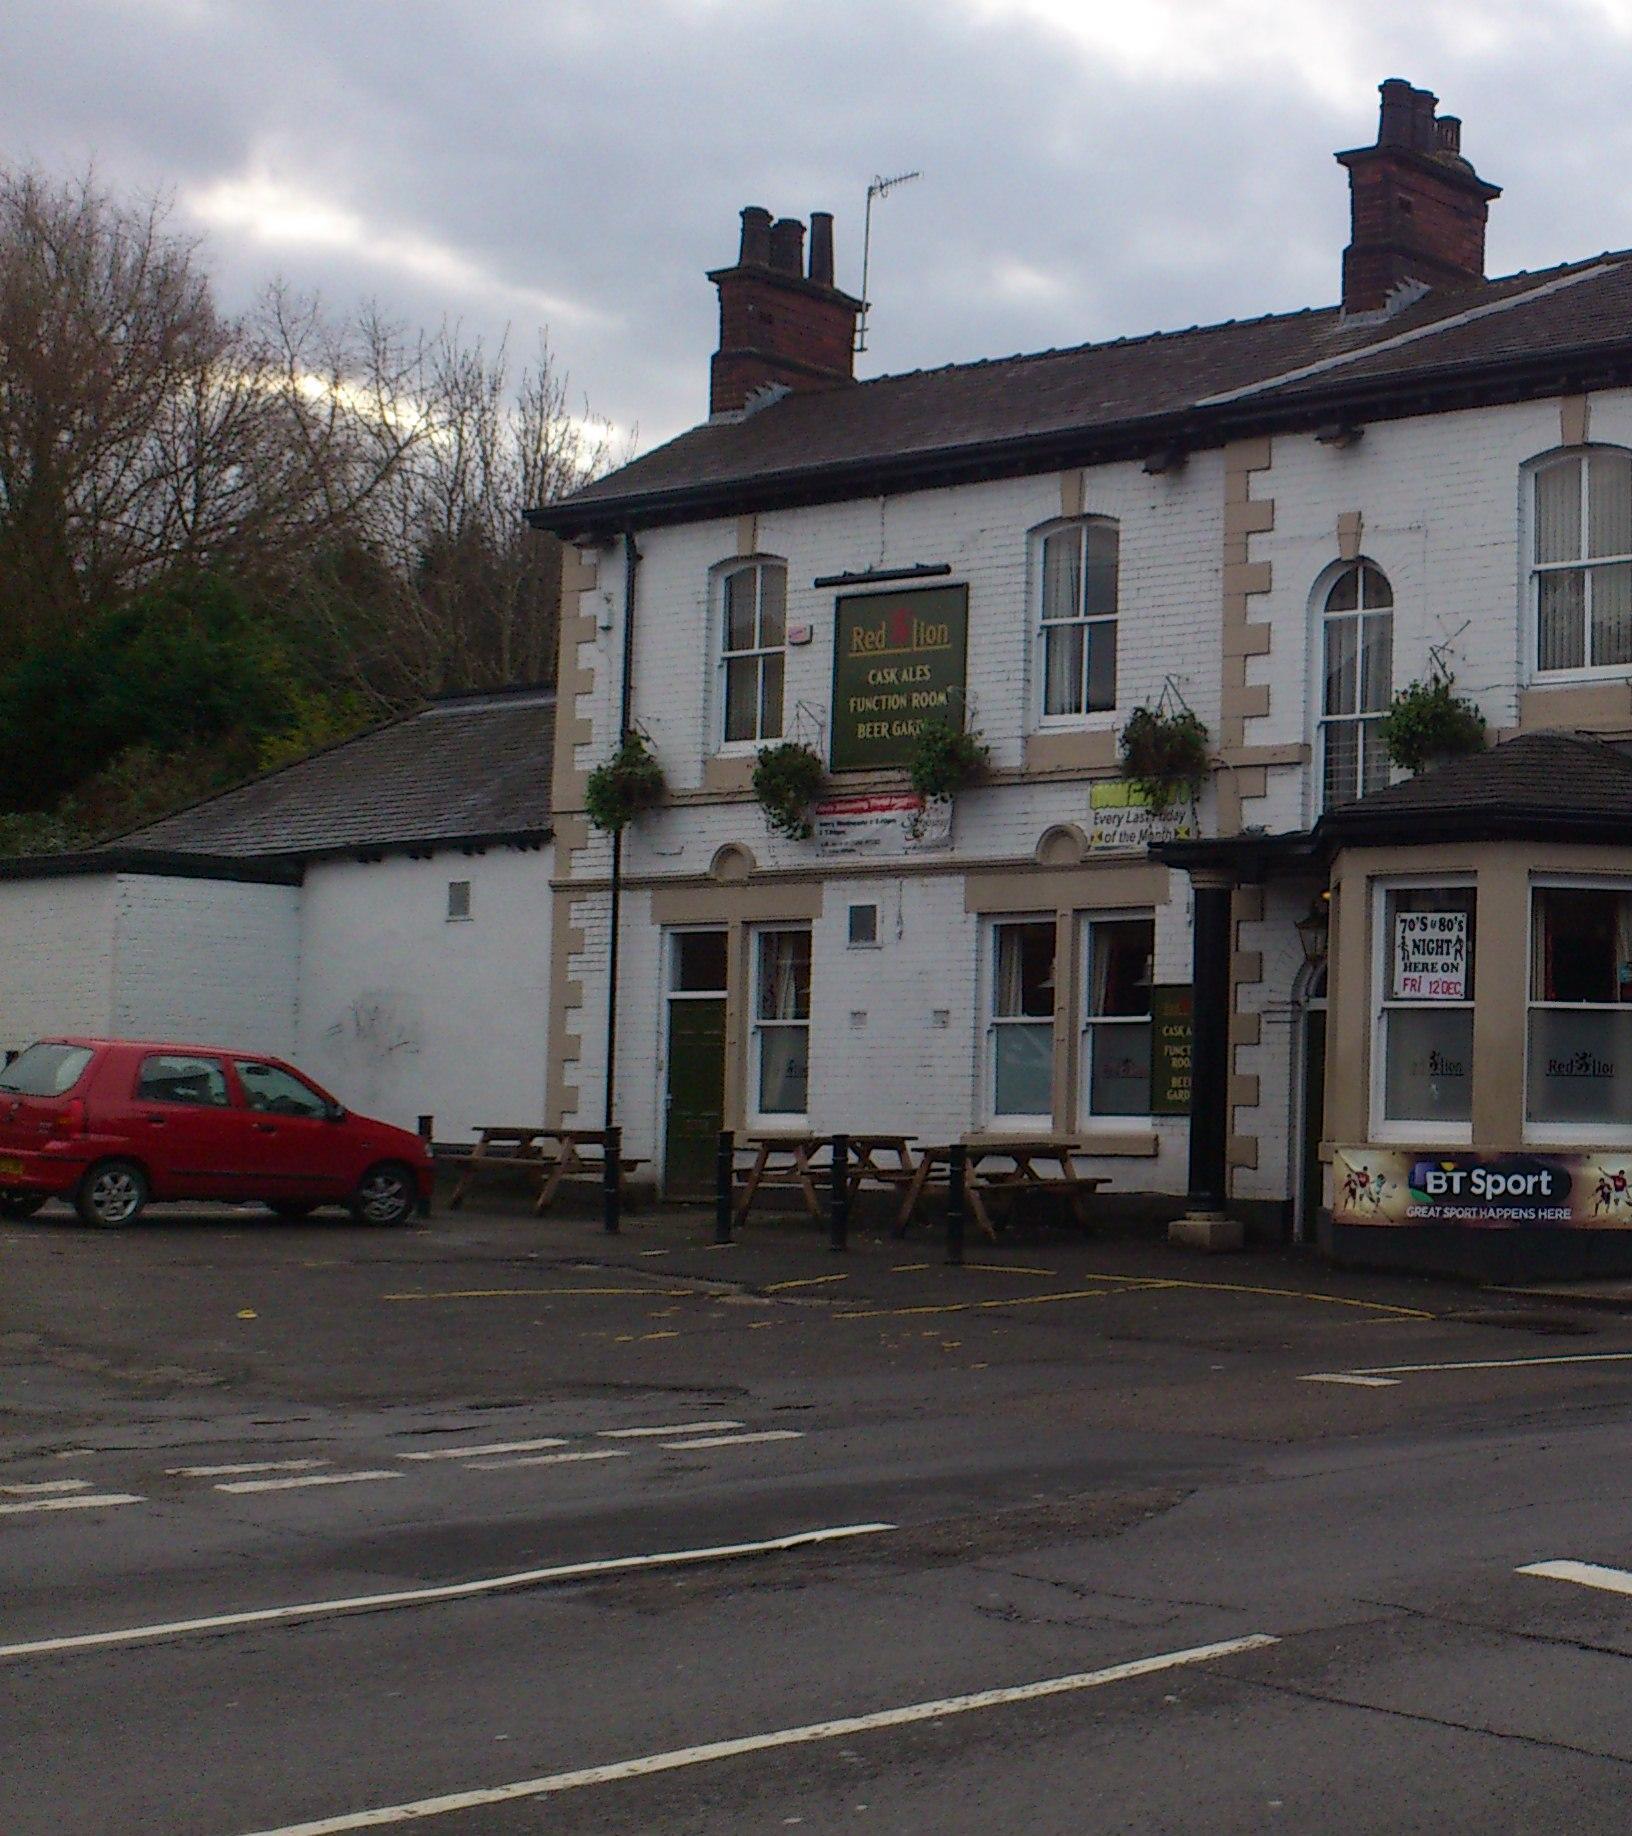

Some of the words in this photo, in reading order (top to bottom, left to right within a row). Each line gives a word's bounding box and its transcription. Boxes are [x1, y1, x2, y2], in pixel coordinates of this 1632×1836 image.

[851, 618, 885, 651] Red
[868, 668, 899, 686] CASK
[901, 665, 931, 684] ALES
[849, 693, 908, 713] FUNCTION
[912, 691, 948, 710] ROOM
[857, 721, 890, 740] BEER
[1094, 811, 1123, 827] Every
[1105, 830, 1116, 843] of
[1119, 830, 1136, 843] the
[1400, 915, 1428, 934] 70'S
[1411, 938, 1453, 956] NIGHT
[1403, 962, 1438, 973] HERE
[1441, 962, 1460, 973] ON
[1426, 1170, 1468, 1194] BT
[1470, 1168, 1552, 1200] Sport
[1406, 1206, 1442, 1219] GREAT
[1443, 1206, 1478, 1219] SPORT
[1479, 1207, 1536, 1220] HAPPENS
[1538, 1208, 1572, 1221] HERE
